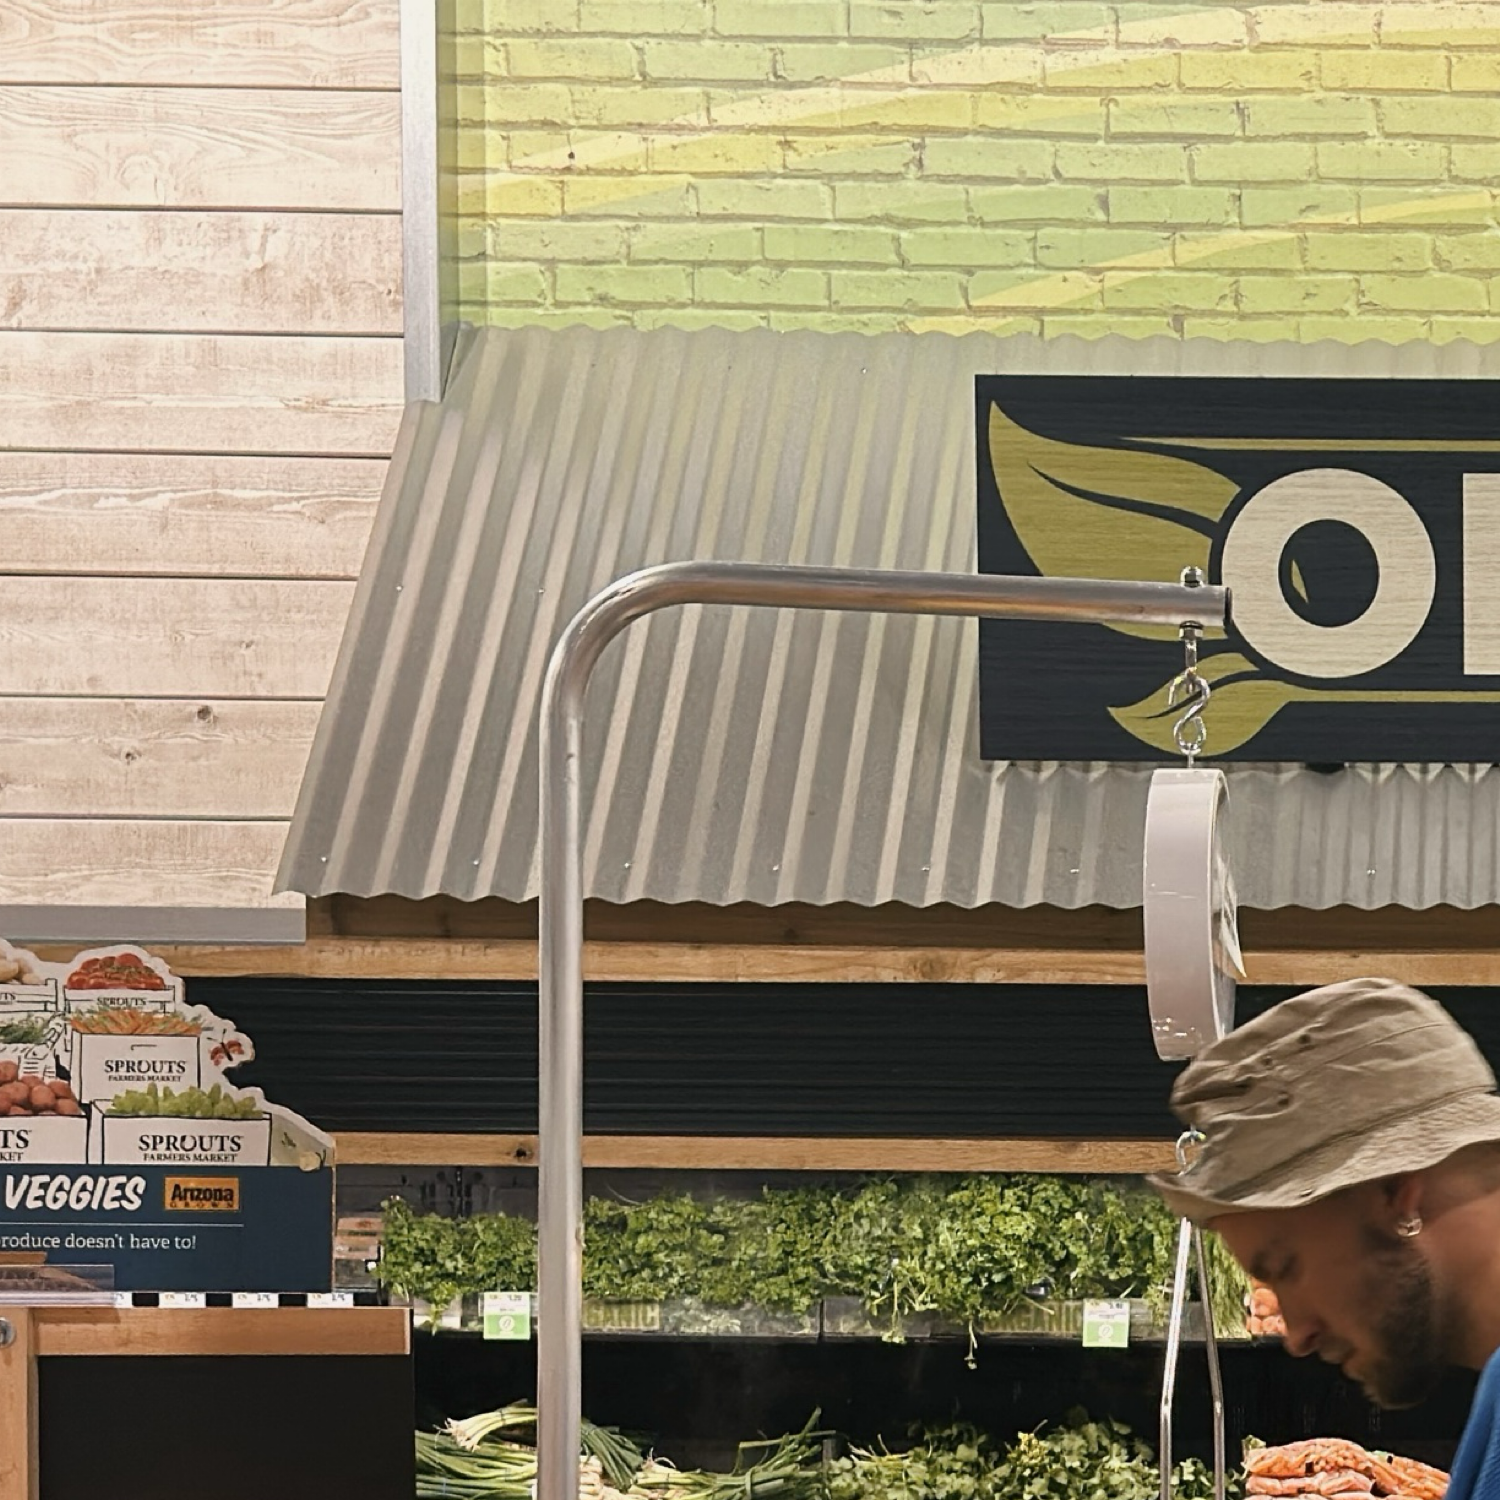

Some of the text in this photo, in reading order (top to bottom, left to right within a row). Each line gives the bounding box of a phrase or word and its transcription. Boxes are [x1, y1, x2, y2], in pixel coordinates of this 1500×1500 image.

[104, 1060, 186, 1074] SPROUTS
[139, 1134, 242, 1152] SPROUTS
[143, 1153, 237, 1163] FARMERS MARKET
[5, 1174, 146, 1210] VEGGIES
[171, 1184, 234, 1201] Arizona
[0, 1232, 197, 1250] roduce doesn't have to!
